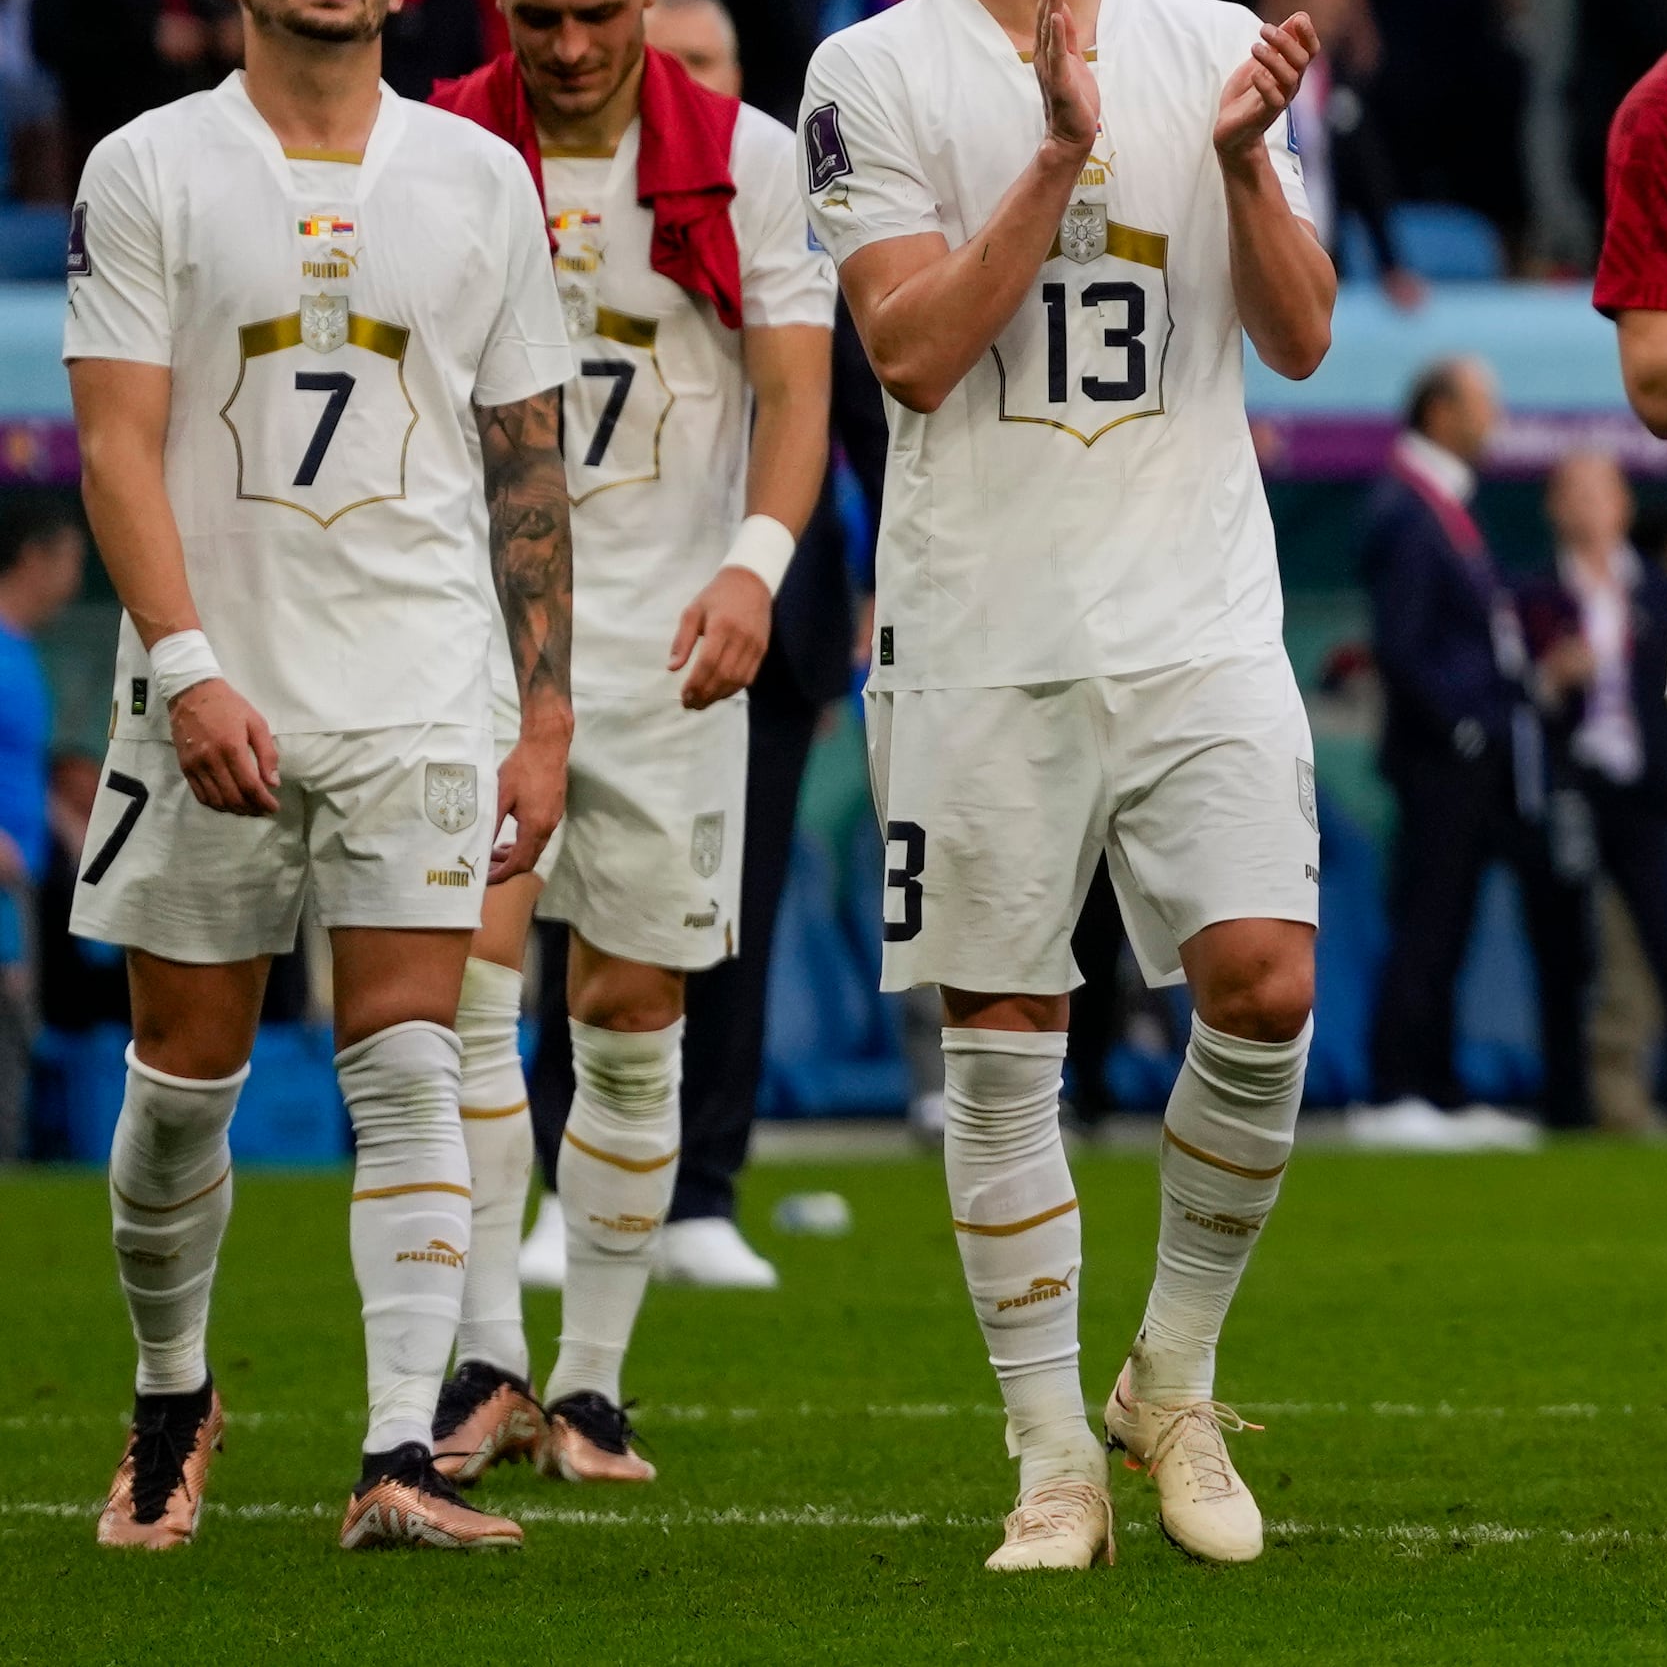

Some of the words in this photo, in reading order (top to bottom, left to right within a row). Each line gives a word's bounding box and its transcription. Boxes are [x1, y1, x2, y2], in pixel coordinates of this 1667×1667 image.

[1078, 168, 1105, 186] MA
[302, 260, 350, 278] PUMA
[1042, 281, 1146, 404] 13
[293, 370, 357, 487] 7
[82, 768, 150, 886] 7
[427, 869, 470, 887] PUMA
[396, 1250, 458, 1268] PUMA
[997, 1286, 1062, 1313] PUMA
